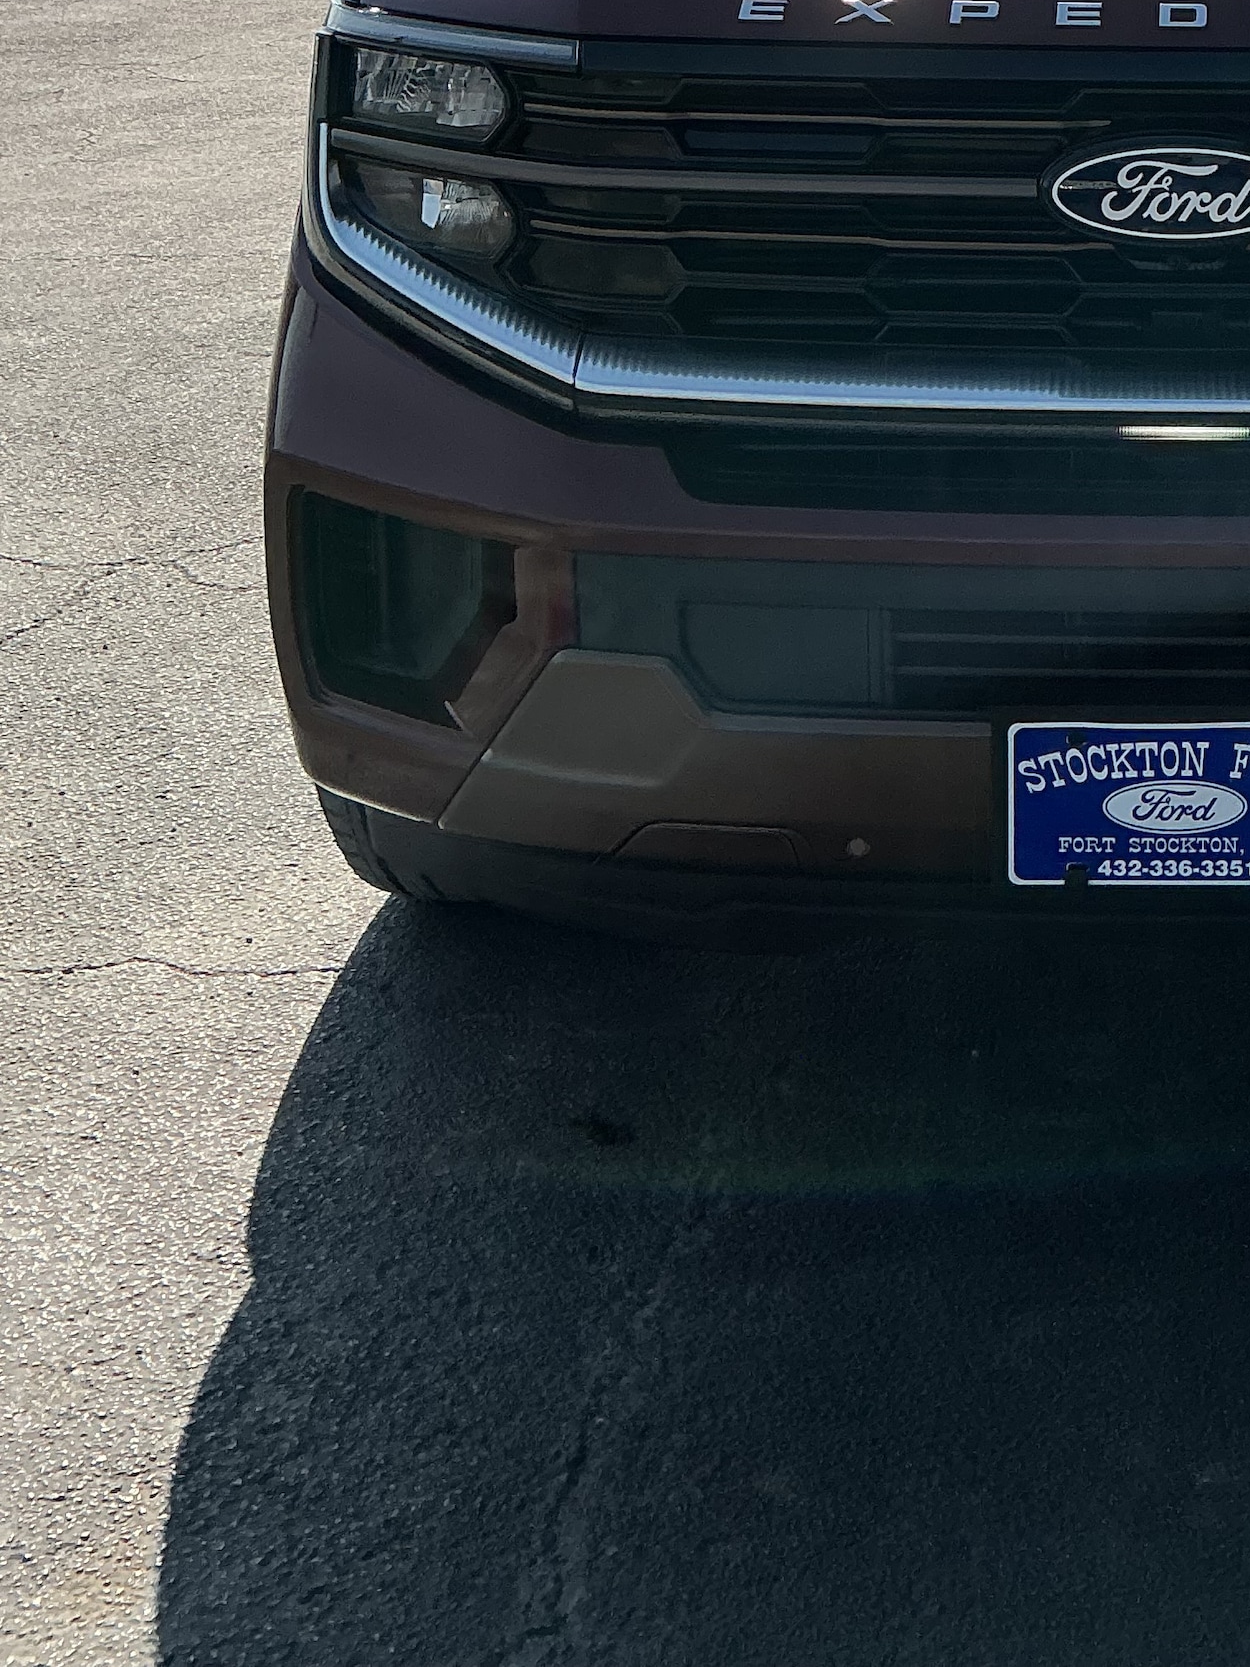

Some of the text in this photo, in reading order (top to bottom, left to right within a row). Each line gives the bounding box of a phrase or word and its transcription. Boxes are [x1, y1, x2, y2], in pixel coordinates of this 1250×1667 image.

[1018, 741, 1210, 793] STOCKTON
[1132, 789, 1217, 821] Ford
[1058, 837, 1116, 853] FORT
[1129, 837, 1245, 855] STOCKTON,
